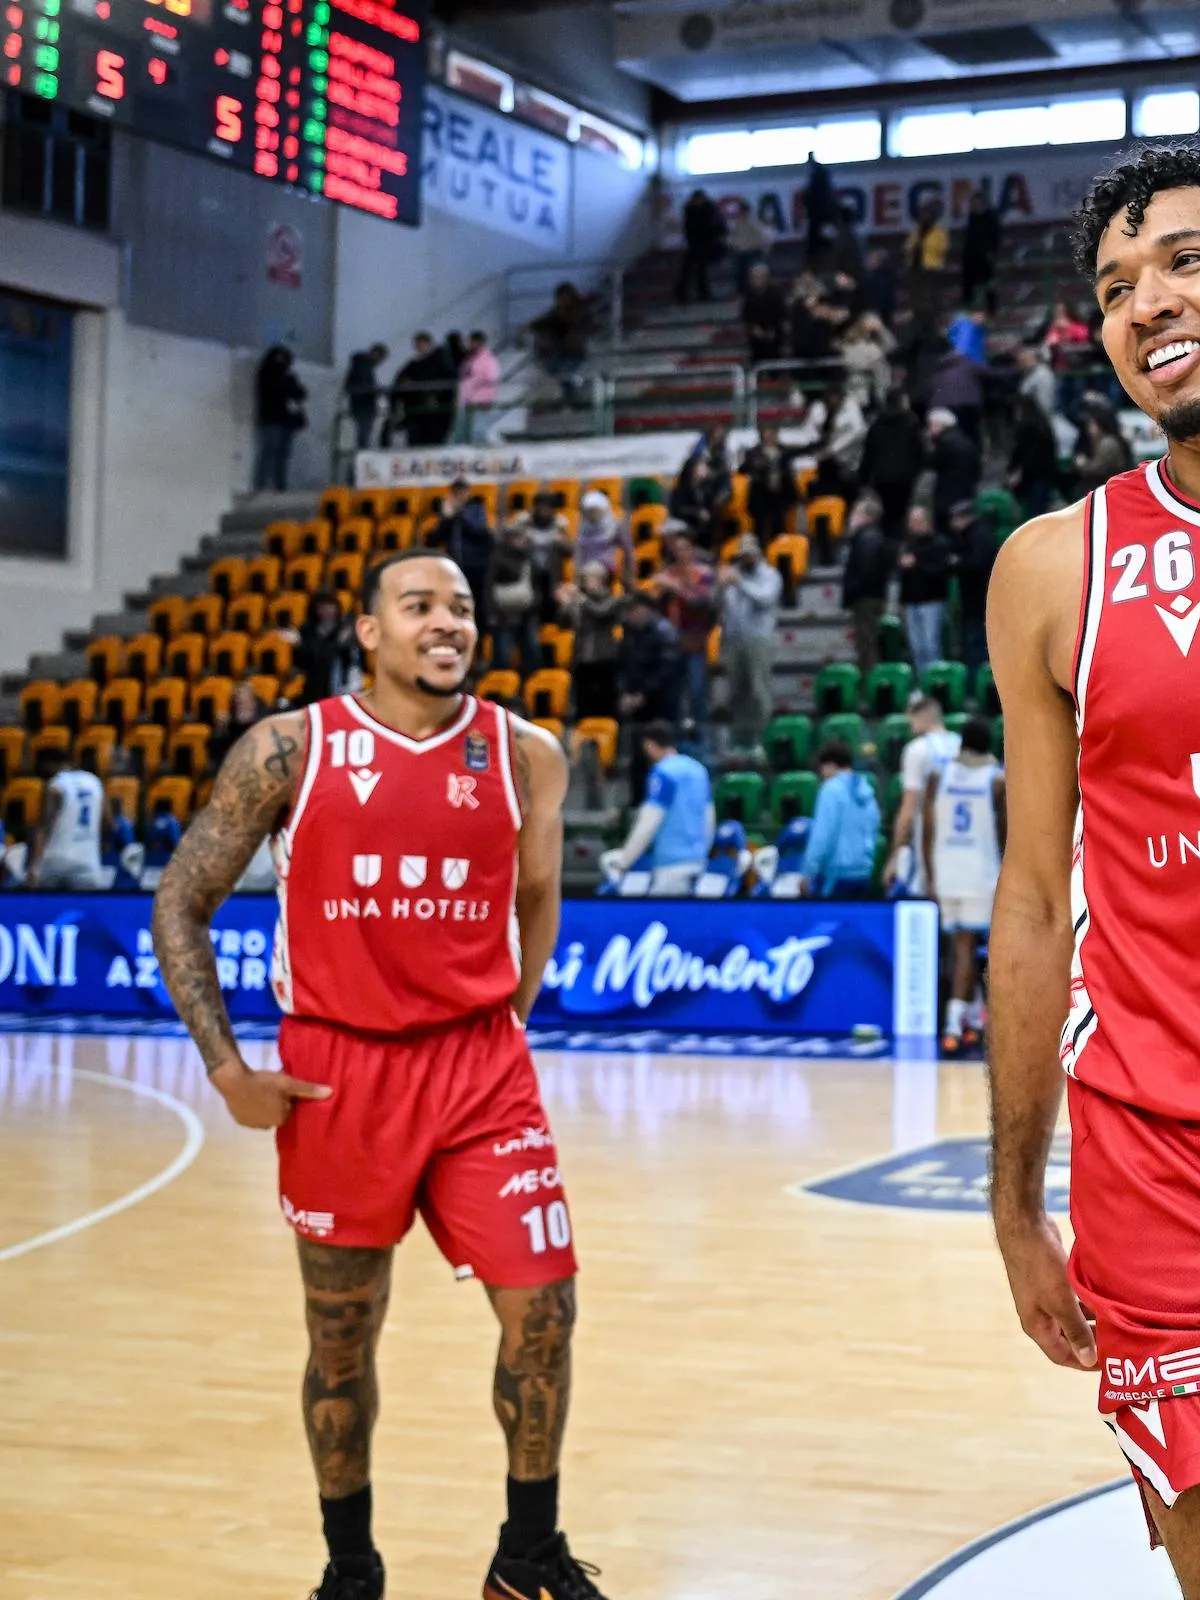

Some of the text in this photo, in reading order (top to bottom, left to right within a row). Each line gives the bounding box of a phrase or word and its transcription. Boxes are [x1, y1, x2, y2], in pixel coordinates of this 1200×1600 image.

[96, 50, 125, 99] 5
[216, 95, 242, 142] 5
[421, 103, 557, 197] REALE
[720, 172, 1032, 236] SADEGNA
[1110, 529, 1196, 605] 26
[326, 729, 375, 768] 10
[323, 897, 491, 921] UNA HOTELS
[0, 923, 80, 987] NI
[593, 920, 833, 1008] Momento
[520, 1200, 571, 1254] 10
[1104, 1389, 1167, 1400] MONTASCALE
